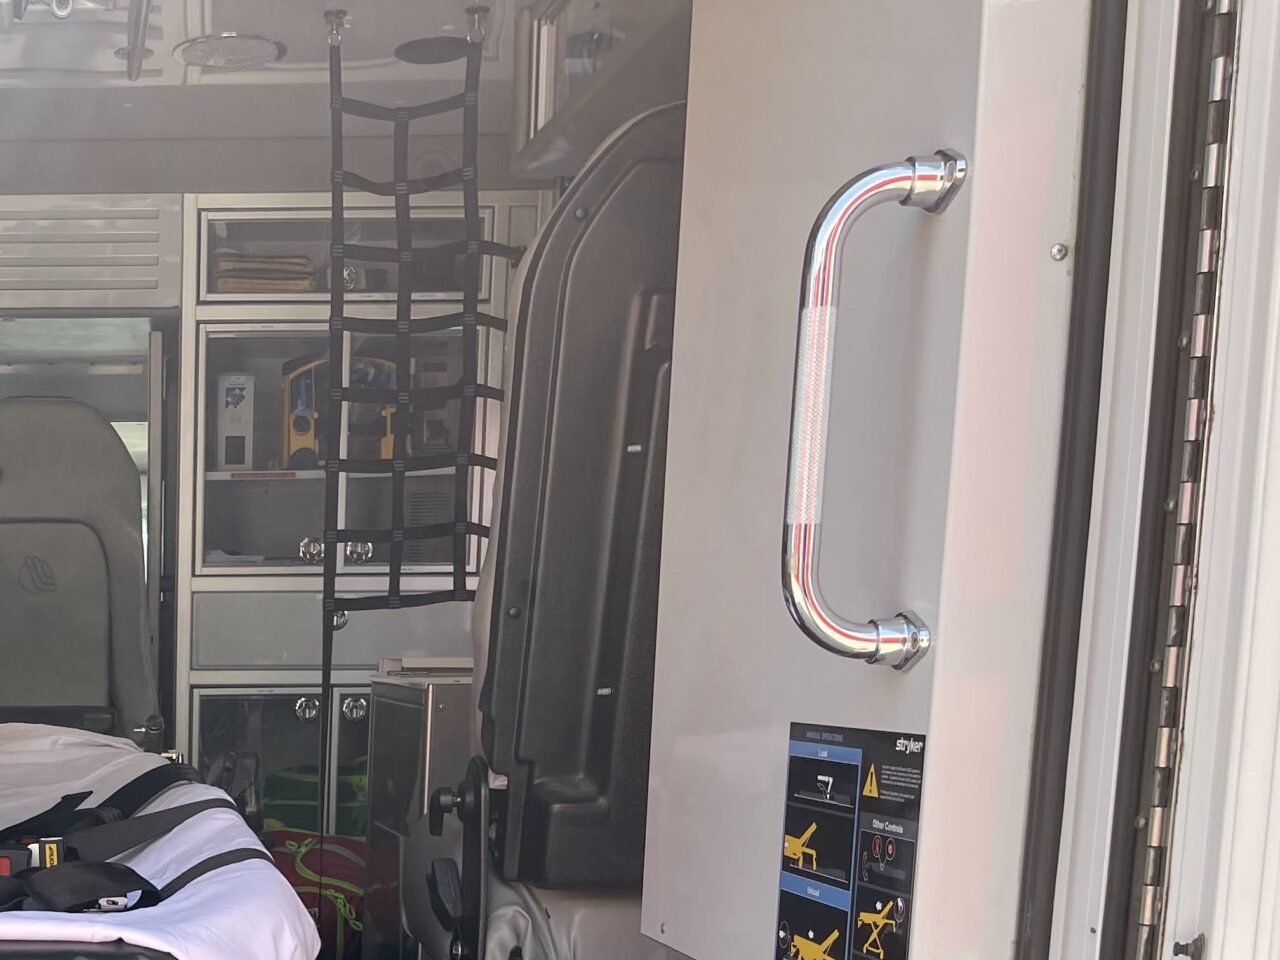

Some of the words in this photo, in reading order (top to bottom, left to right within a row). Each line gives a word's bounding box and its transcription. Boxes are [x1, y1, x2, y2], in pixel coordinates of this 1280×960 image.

[895, 736, 923, 754] stryker
[872, 819, 884, 830] Other
[884, 821, 903, 834] Controls
